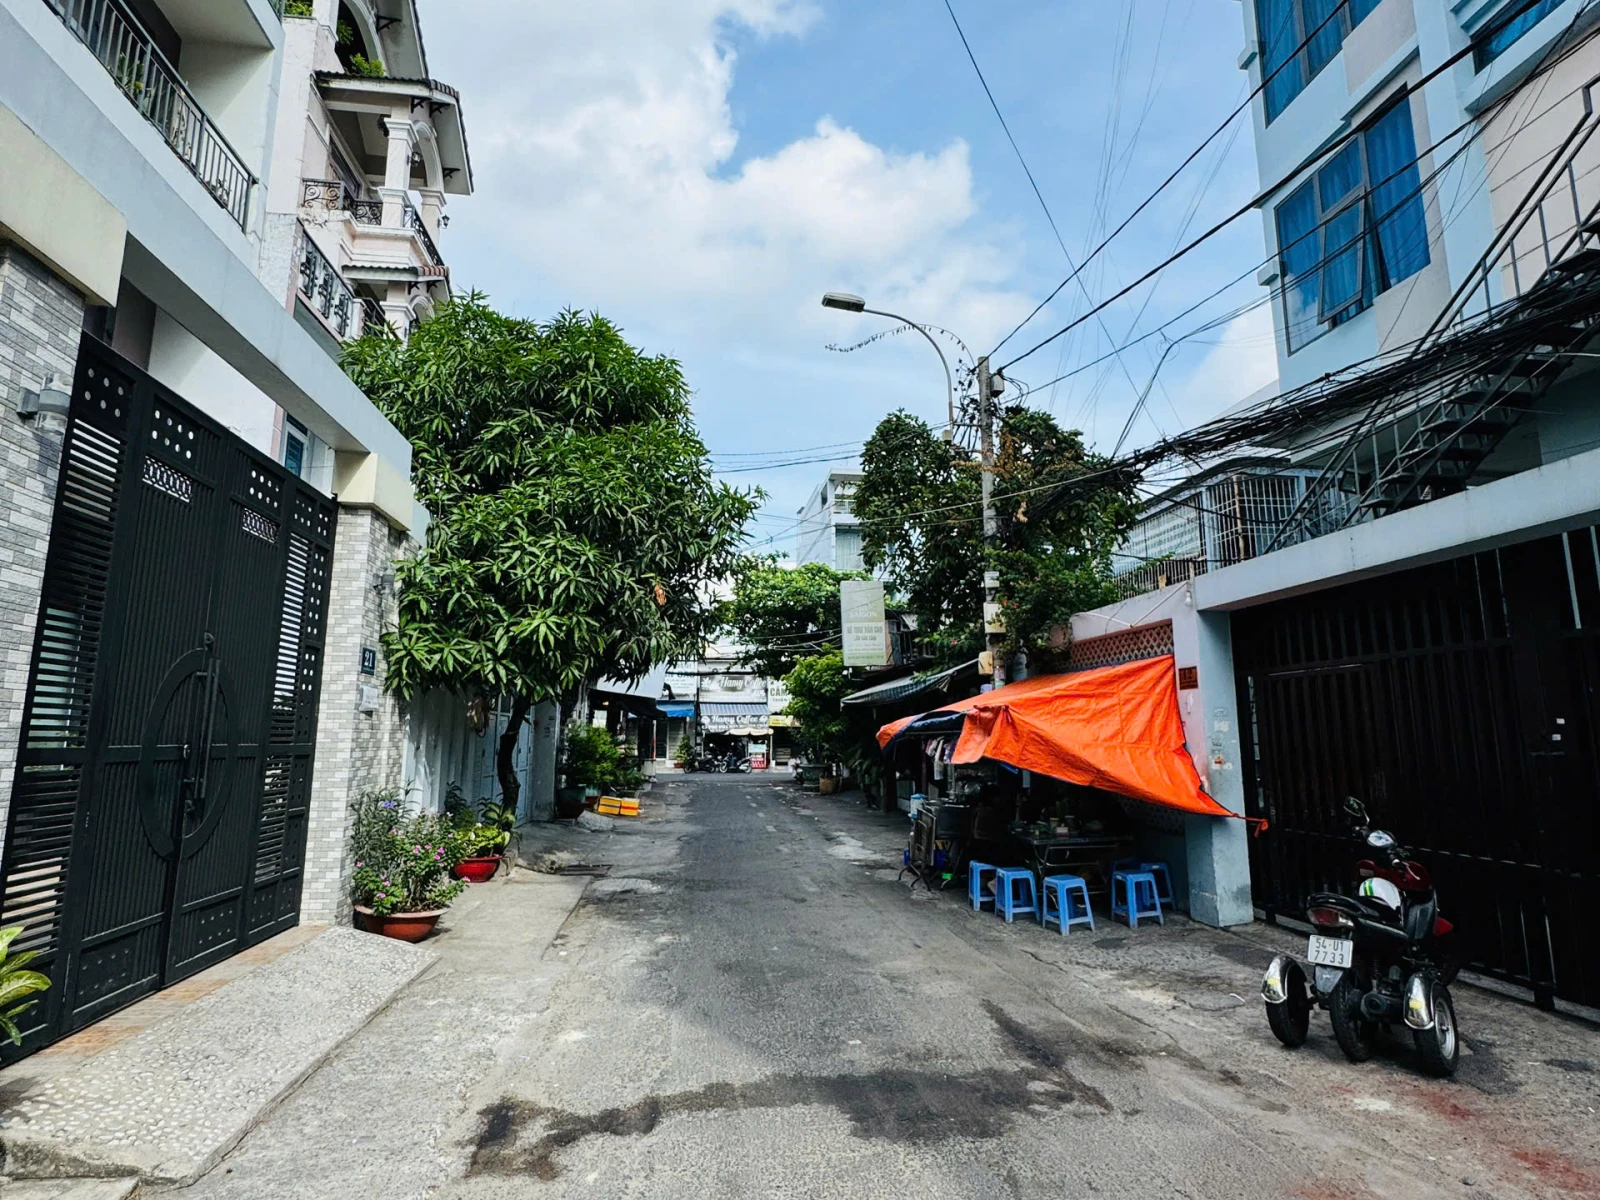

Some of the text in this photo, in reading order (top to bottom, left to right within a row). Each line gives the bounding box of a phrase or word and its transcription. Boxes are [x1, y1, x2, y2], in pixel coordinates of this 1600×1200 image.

[364, 650, 373, 667] 21
[744, 677, 767, 688] Coffee
[736, 715, 758, 725] Coffee
[1314, 949, 1344, 965] 7733
